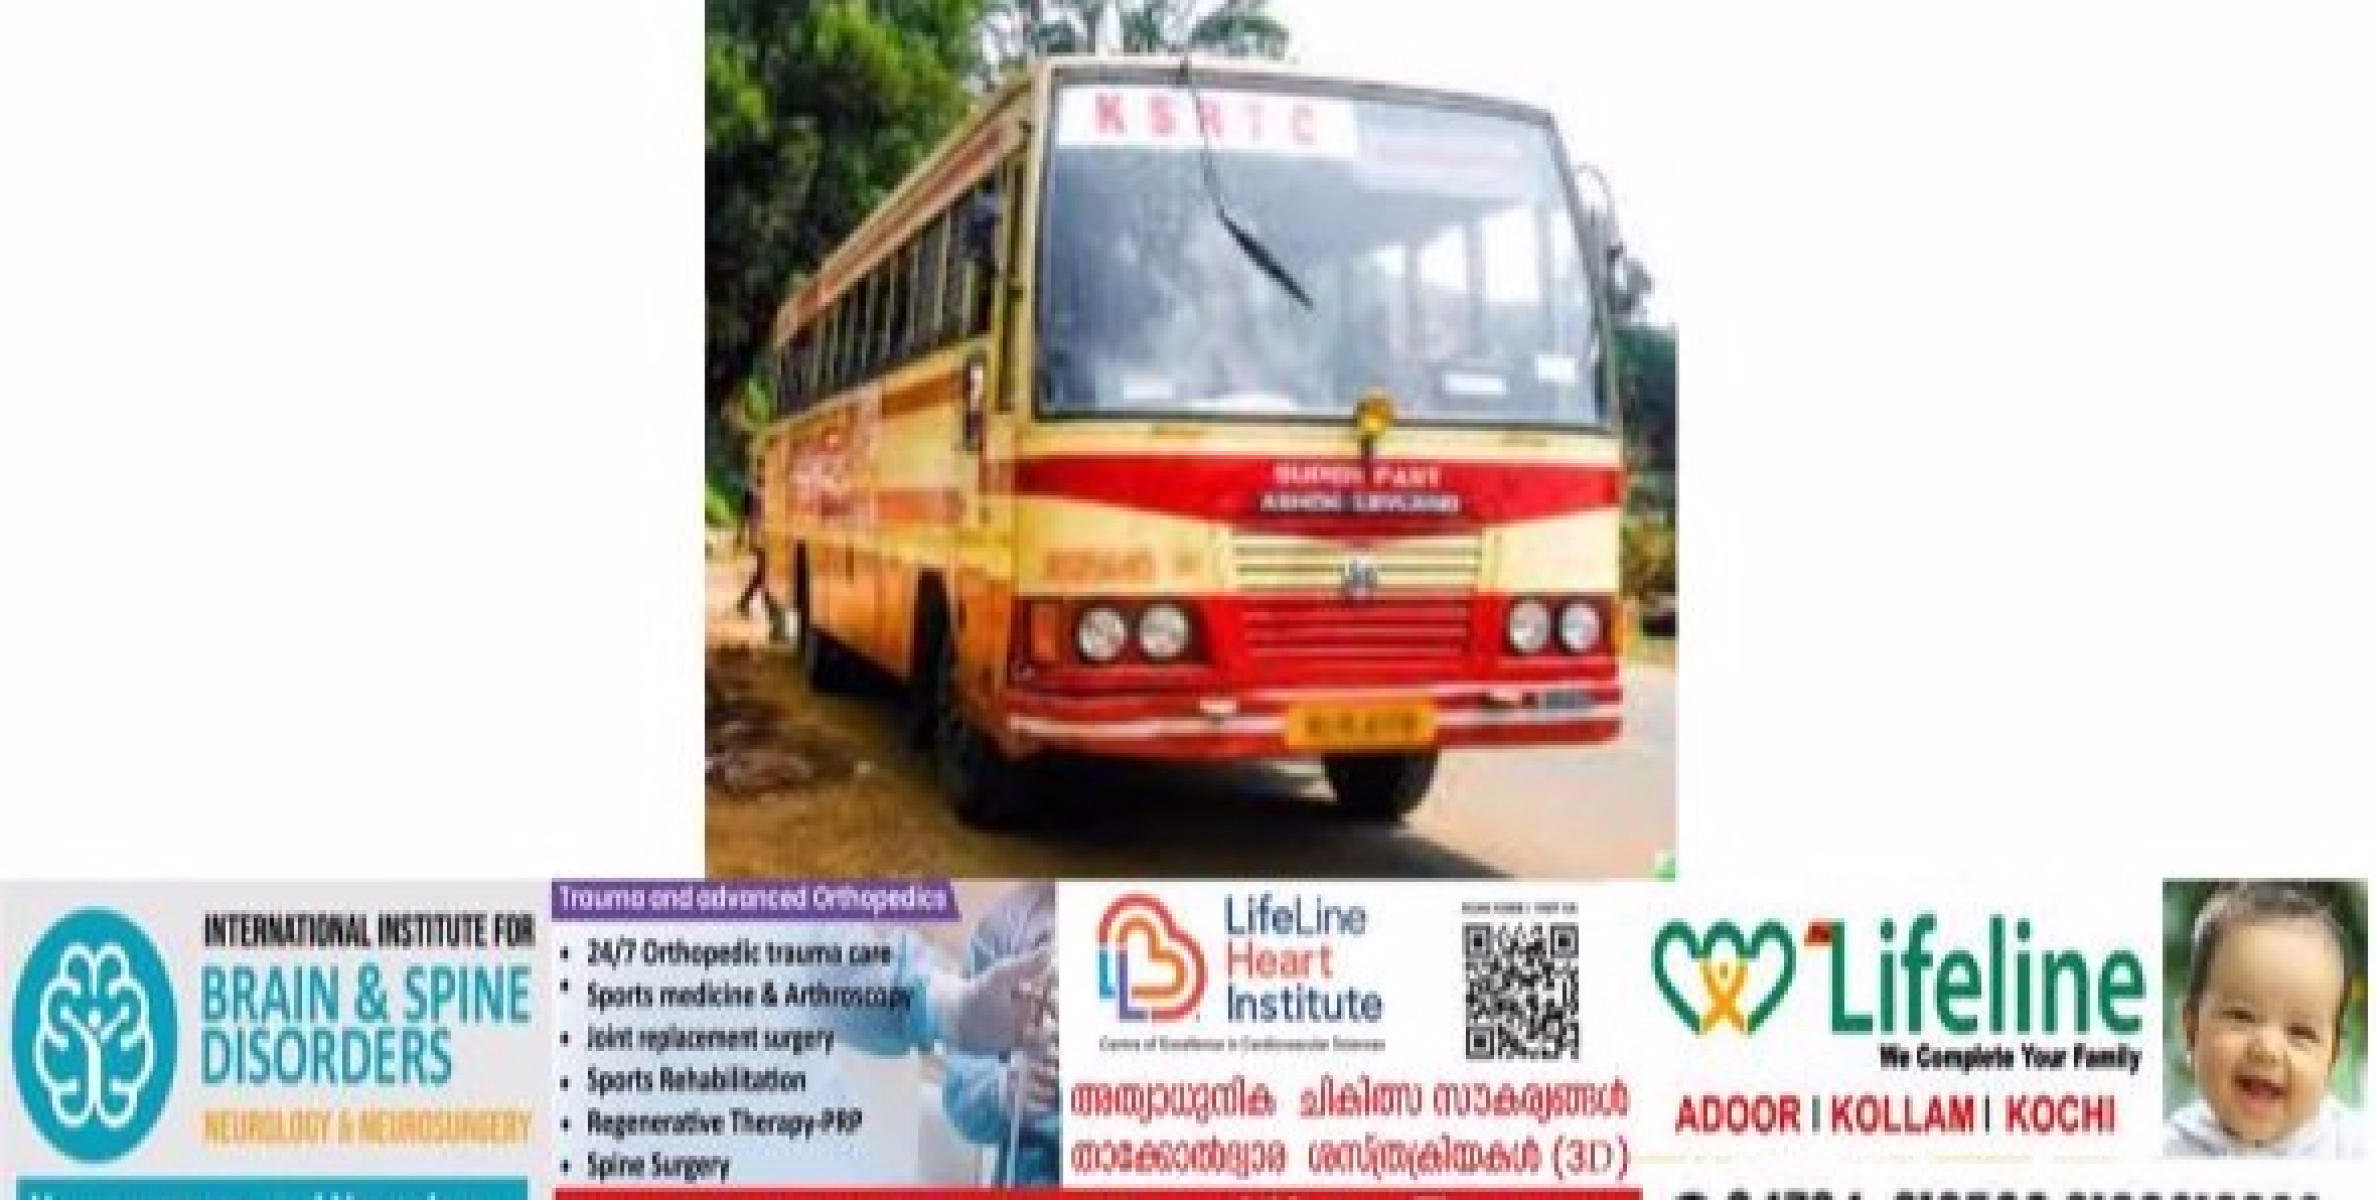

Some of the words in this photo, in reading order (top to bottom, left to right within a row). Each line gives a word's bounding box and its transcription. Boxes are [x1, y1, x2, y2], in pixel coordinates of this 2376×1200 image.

[559, 886, 645, 912] Trauma
[649, 886, 694, 912] and
[699, 886, 807, 912] advanced
[812, 886, 948, 917] Orthopedics
[1224, 893, 1368, 936] LifeLine
[204, 911, 370, 949] INTERNATIONAL
[377, 911, 488, 949] INSTITUTE
[494, 911, 536, 949] FOR
[587, 941, 637, 966] 24/7
[643, 940, 758, 970] Orthopedic
[768, 942, 842, 964] trauma
[848, 945, 892, 964] care
[1226, 941, 1334, 979] Heart
[203, 964, 339, 1022] BRAIN
[356, 962, 390, 1022] &
[405, 964, 531, 1022] SPINE
[1830, 914, 2148, 1036] Lifeline
[587, 981, 653, 1013] Sports
[660, 980, 754, 1007] medicine
[760, 980, 778, 1007] &
[785, 980, 913, 1012] Arthroscopy
[1226, 982, 1383, 1023] Institute
[203, 1028, 453, 1085] DISORDERS
[587, 1024, 633, 1048] Joint
[640, 1025, 758, 1055] replacement
[764, 1030, 835, 1055] surgery
[1880, 1043, 1910, 1069] We
[1917, 1043, 2015, 1075] Complete
[2021, 1043, 2067, 1068] Your
[2073, 1043, 2143, 1075] Family
[587, 1066, 653, 1098] Sports
[660, 1065, 807, 1091] Rehabilitation
[205, 1111, 331, 1144] NEUROLOGY
[358, 1111, 533, 1144] NEUROSURGERY
[587, 1110, 723, 1140] Regenerative
[1675, 1095, 1801, 1133] ADOOR
[1831, 1095, 1975, 1133] KOLLAM
[2006, 1095, 2116, 1133] KOCHI
[587, 1152, 645, 1181] Spine
[651, 1151, 731, 1182] Surgery
[1552, 1133, 1630, 1181] (3D)
